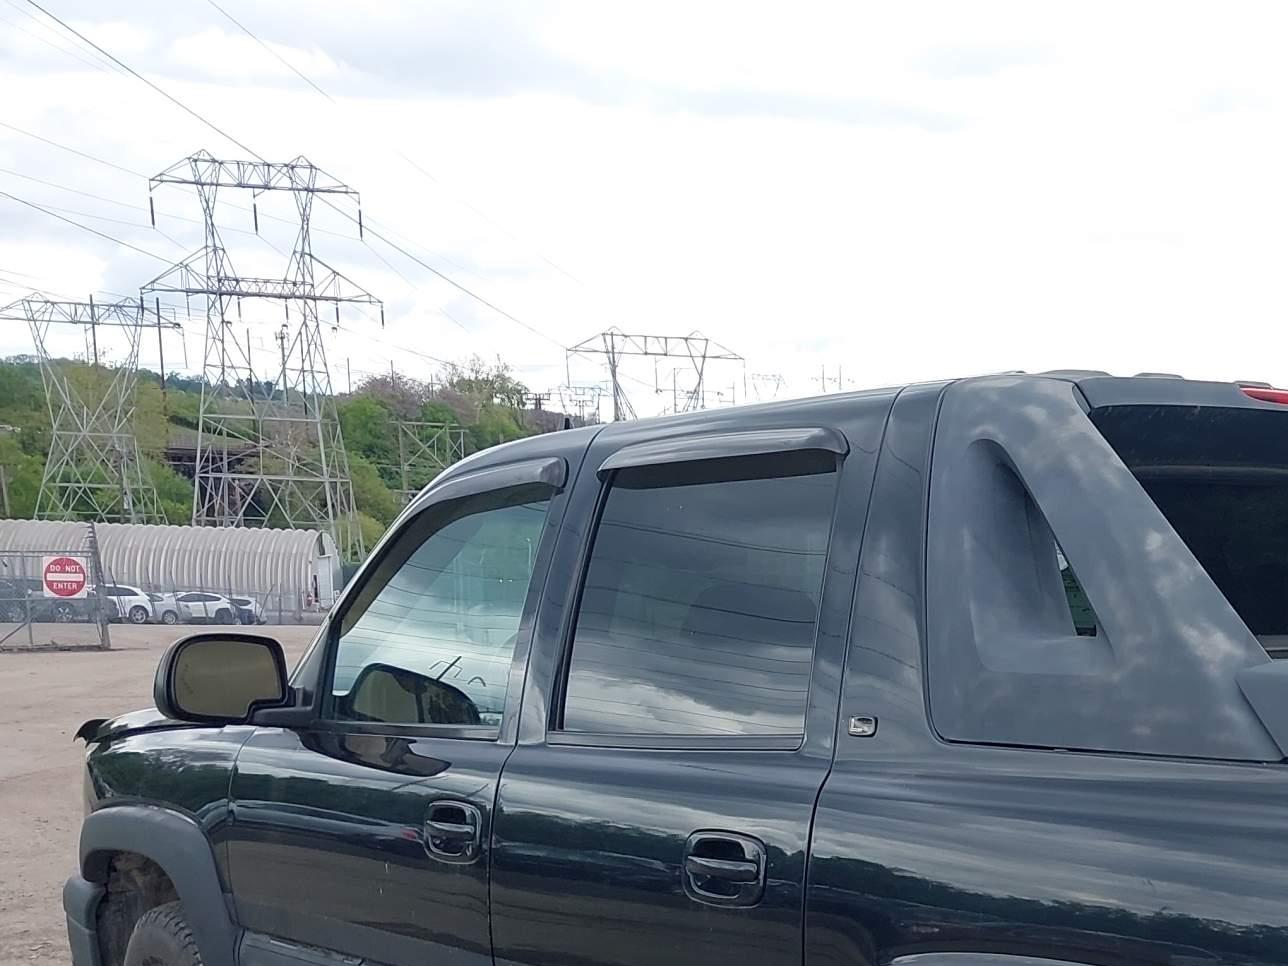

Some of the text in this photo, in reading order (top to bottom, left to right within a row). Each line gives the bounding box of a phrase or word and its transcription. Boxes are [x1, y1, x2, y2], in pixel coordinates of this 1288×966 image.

[50, 564, 81, 572] DO NOT
[53, 582, 77, 590] ENTER
